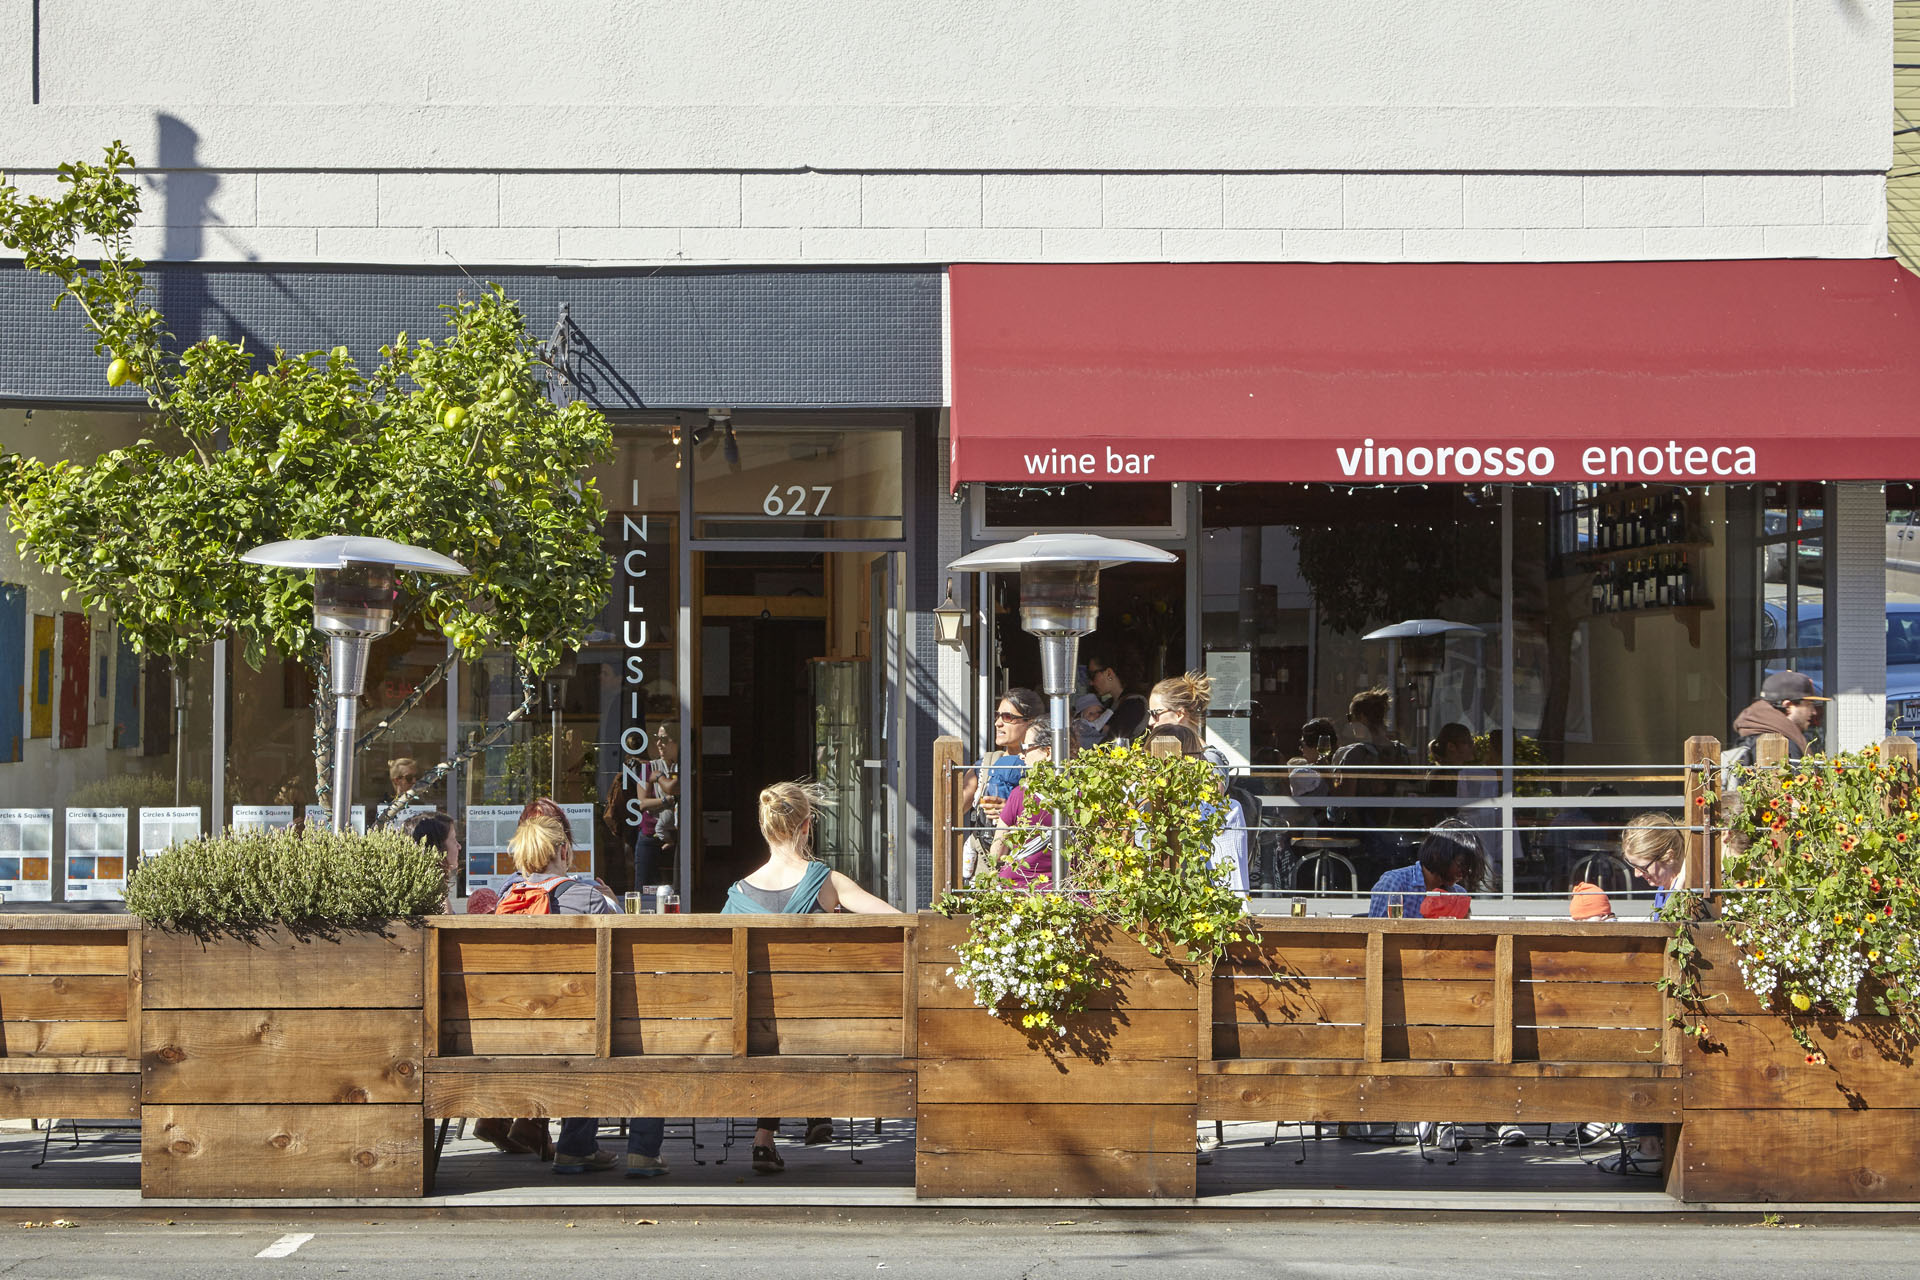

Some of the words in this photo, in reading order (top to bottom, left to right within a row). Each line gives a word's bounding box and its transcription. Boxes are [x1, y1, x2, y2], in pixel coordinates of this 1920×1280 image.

[1024, 447, 1096, 475] wine
[1106, 446, 1155, 475] bar
[1336, 438, 1555, 476] vinorosso
[1582, 441, 1756, 475] enoteca
[763, 485, 833, 516] 627
[621, 479, 649, 827] INCLUSIONS
[23, 812, 51, 820] Squares
